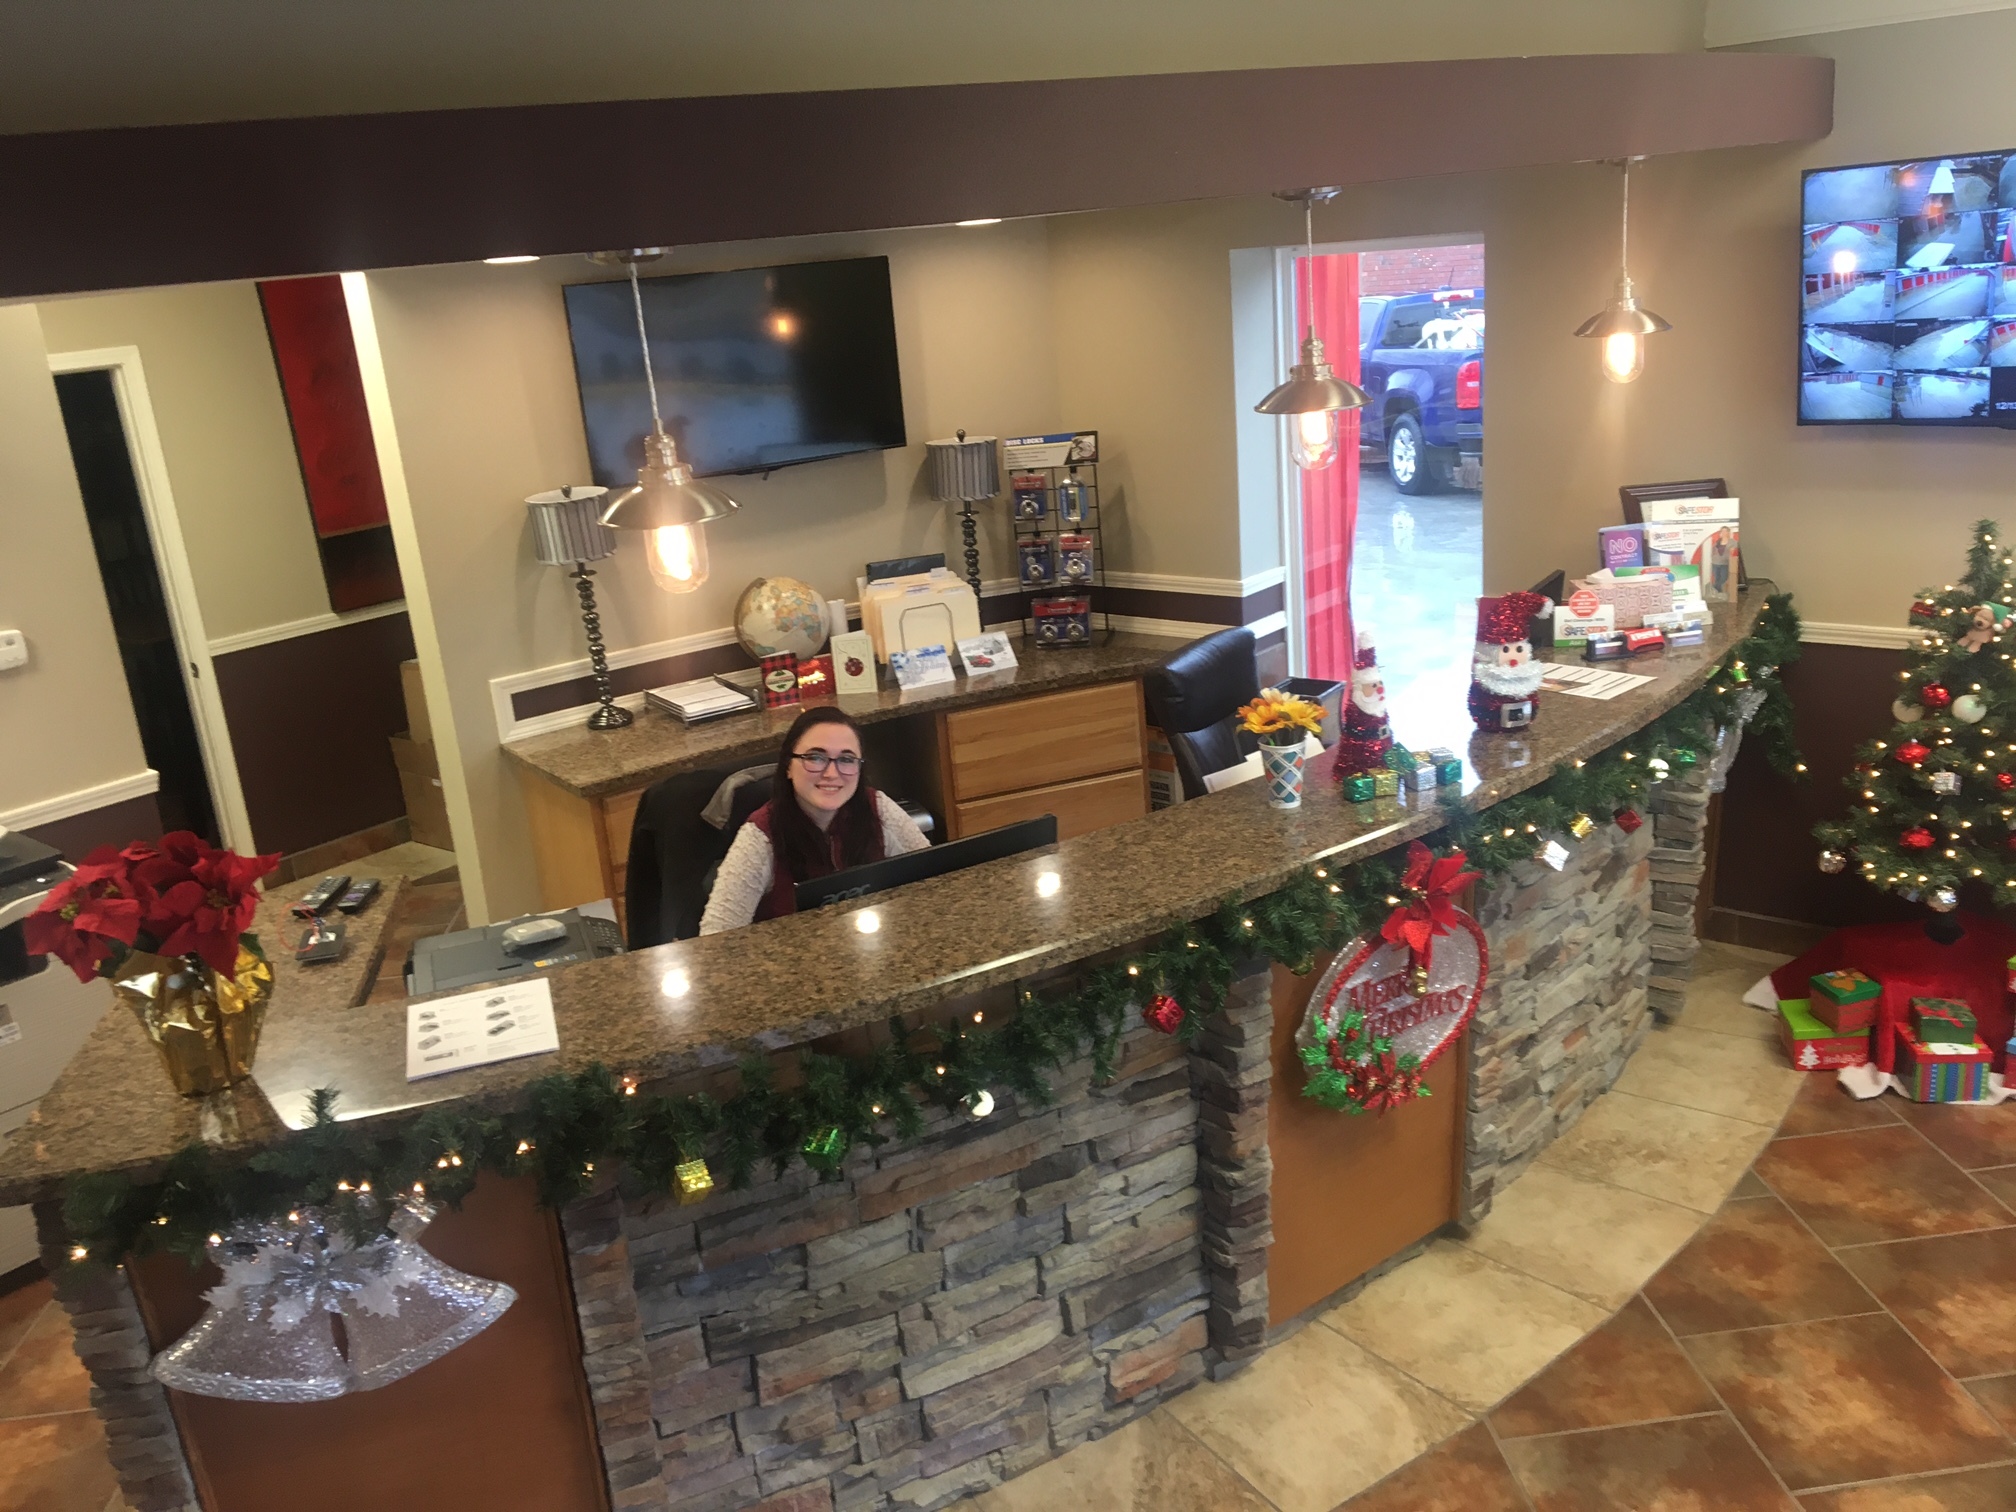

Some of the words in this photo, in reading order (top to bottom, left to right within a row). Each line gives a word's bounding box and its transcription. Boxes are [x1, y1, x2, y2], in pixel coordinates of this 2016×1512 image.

[1022, 437, 1044, 445] LOCKS
[1678, 505, 1714, 515] SAFESTOR
[1609, 536, 1638, 554] NO
